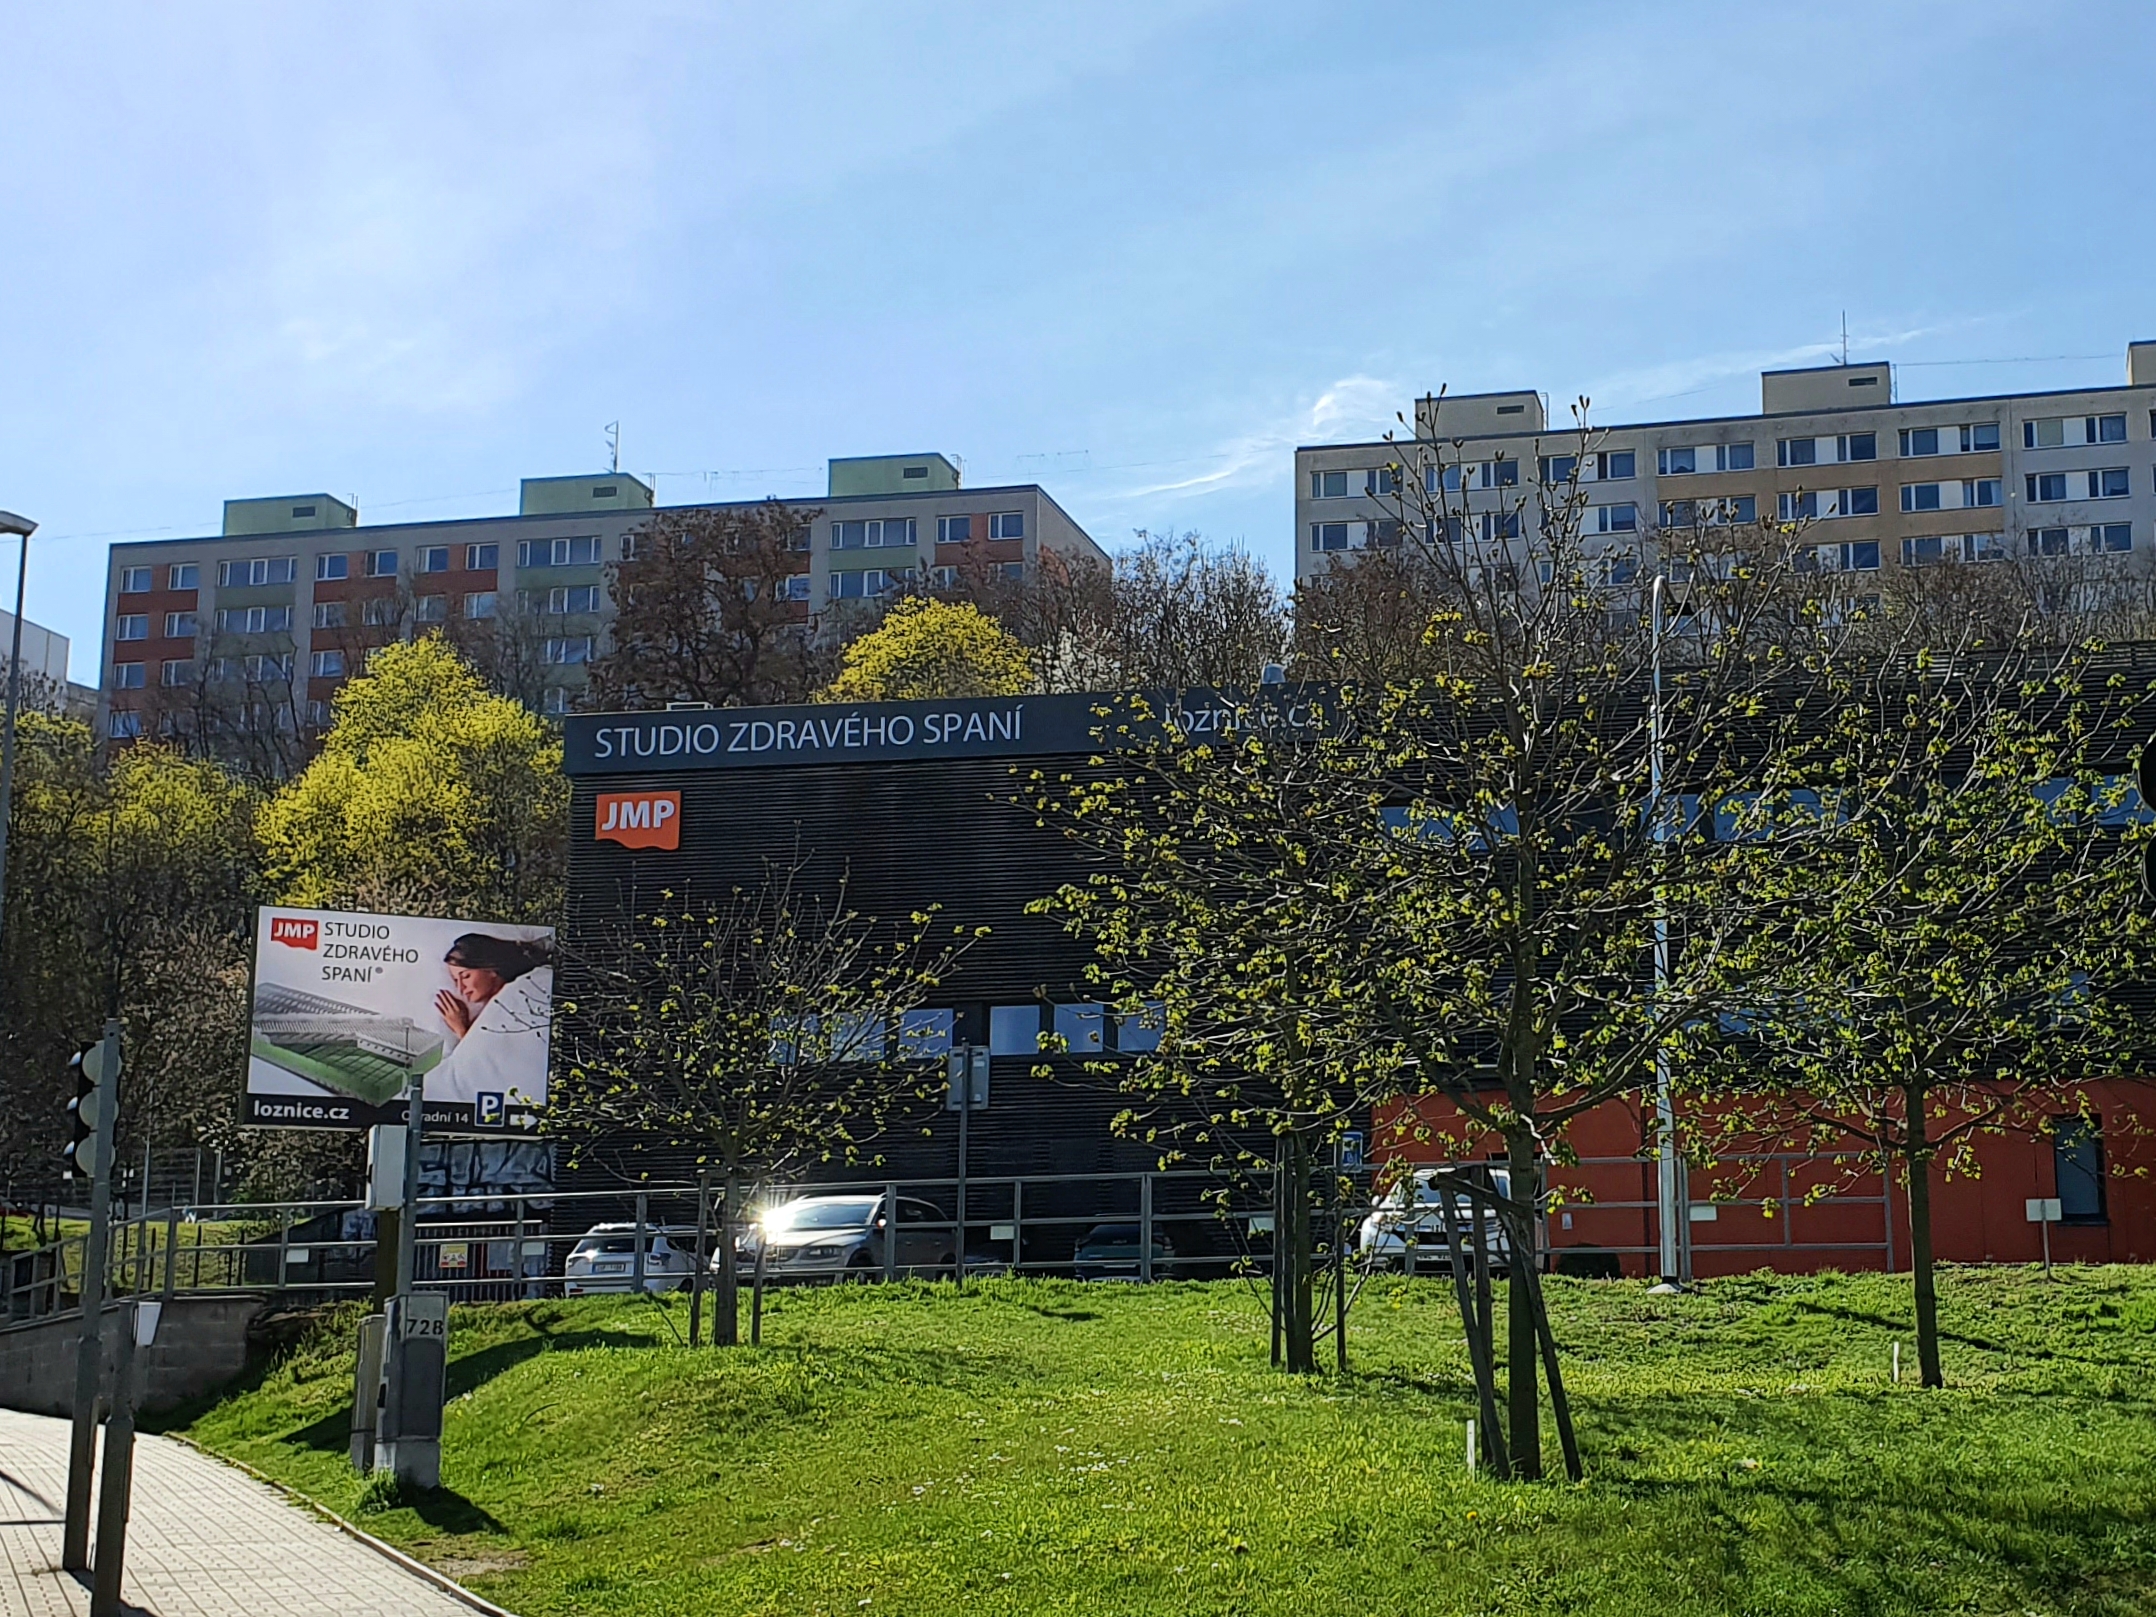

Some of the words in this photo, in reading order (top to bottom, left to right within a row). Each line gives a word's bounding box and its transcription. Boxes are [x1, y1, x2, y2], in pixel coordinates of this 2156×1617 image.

[594, 723, 720, 758] STUDIO
[727, 711, 915, 752] ZDRAVÉHO
[922, 703, 1024, 744] SPANÍ
[601, 799, 675, 832] JMP
[273, 922, 316, 939] JMP
[324, 921, 390, 940] STUDIO
[322, 943, 419, 964] ZDRAVÉHO
[253, 1100, 350, 1120] loznice.cz
[481, 1095, 499, 1118] P
[401, 1110, 452, 1123] Oradní
[455, 1112, 469, 1124] 14
[406, 1319, 444, 1335] 728
